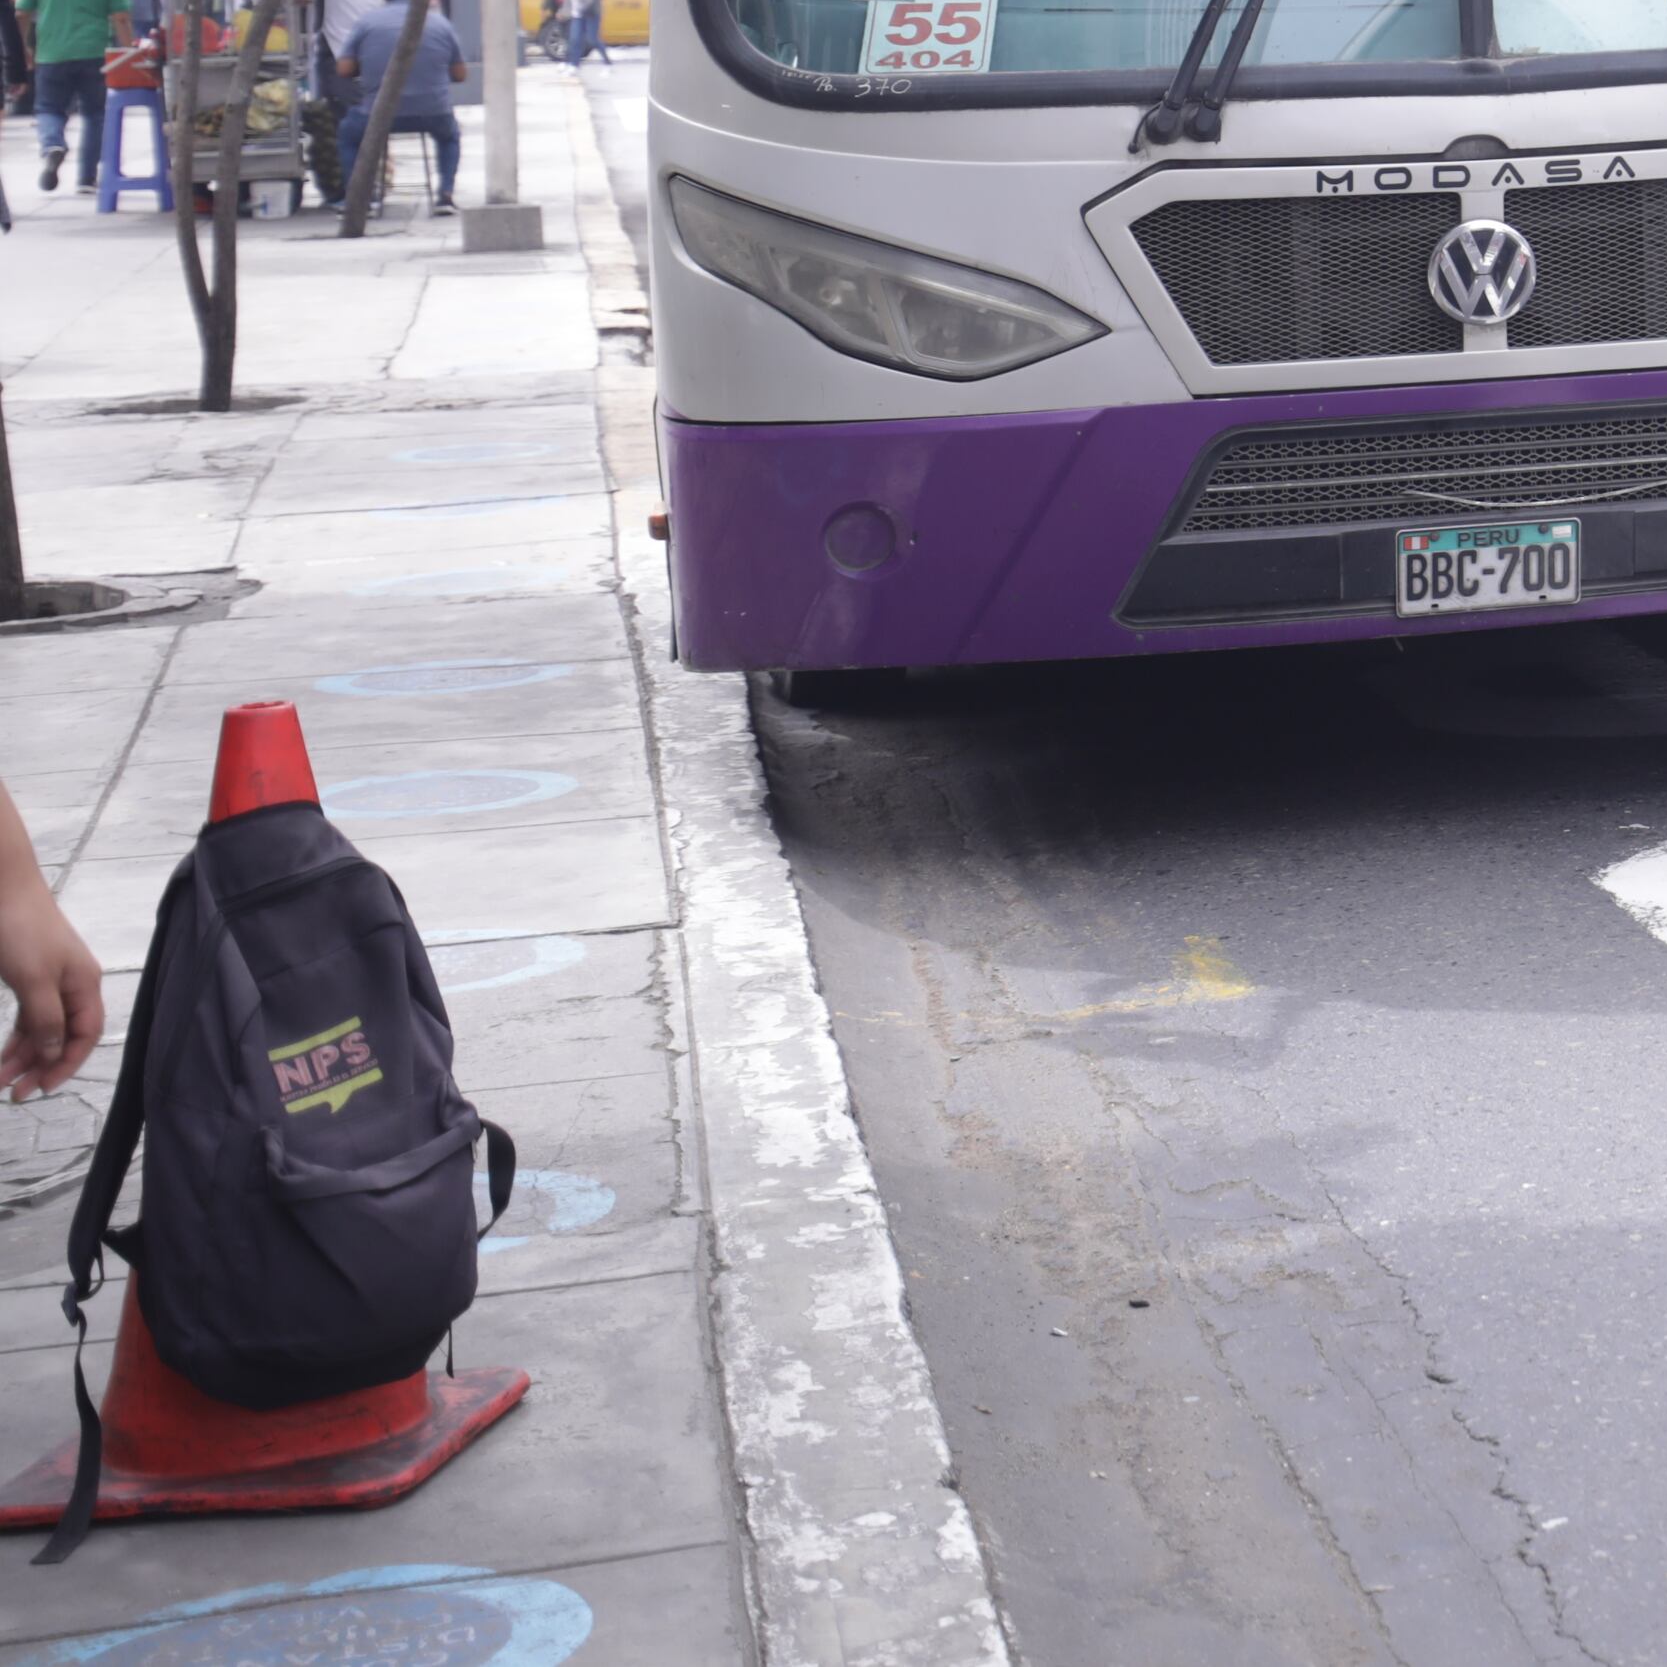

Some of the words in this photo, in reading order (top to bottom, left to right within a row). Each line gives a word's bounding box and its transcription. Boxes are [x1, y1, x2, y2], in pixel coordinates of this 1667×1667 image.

[884, 2, 982, 46] 55
[874, 50, 975, 69] 404
[855, 77, 912, 98] 370
[1316, 155, 1636, 193] MODASA
[1457, 528, 1520, 548] PERU
[1406, 542, 1571, 602] BBC-700
[272, 1031, 371, 1093] NPS
